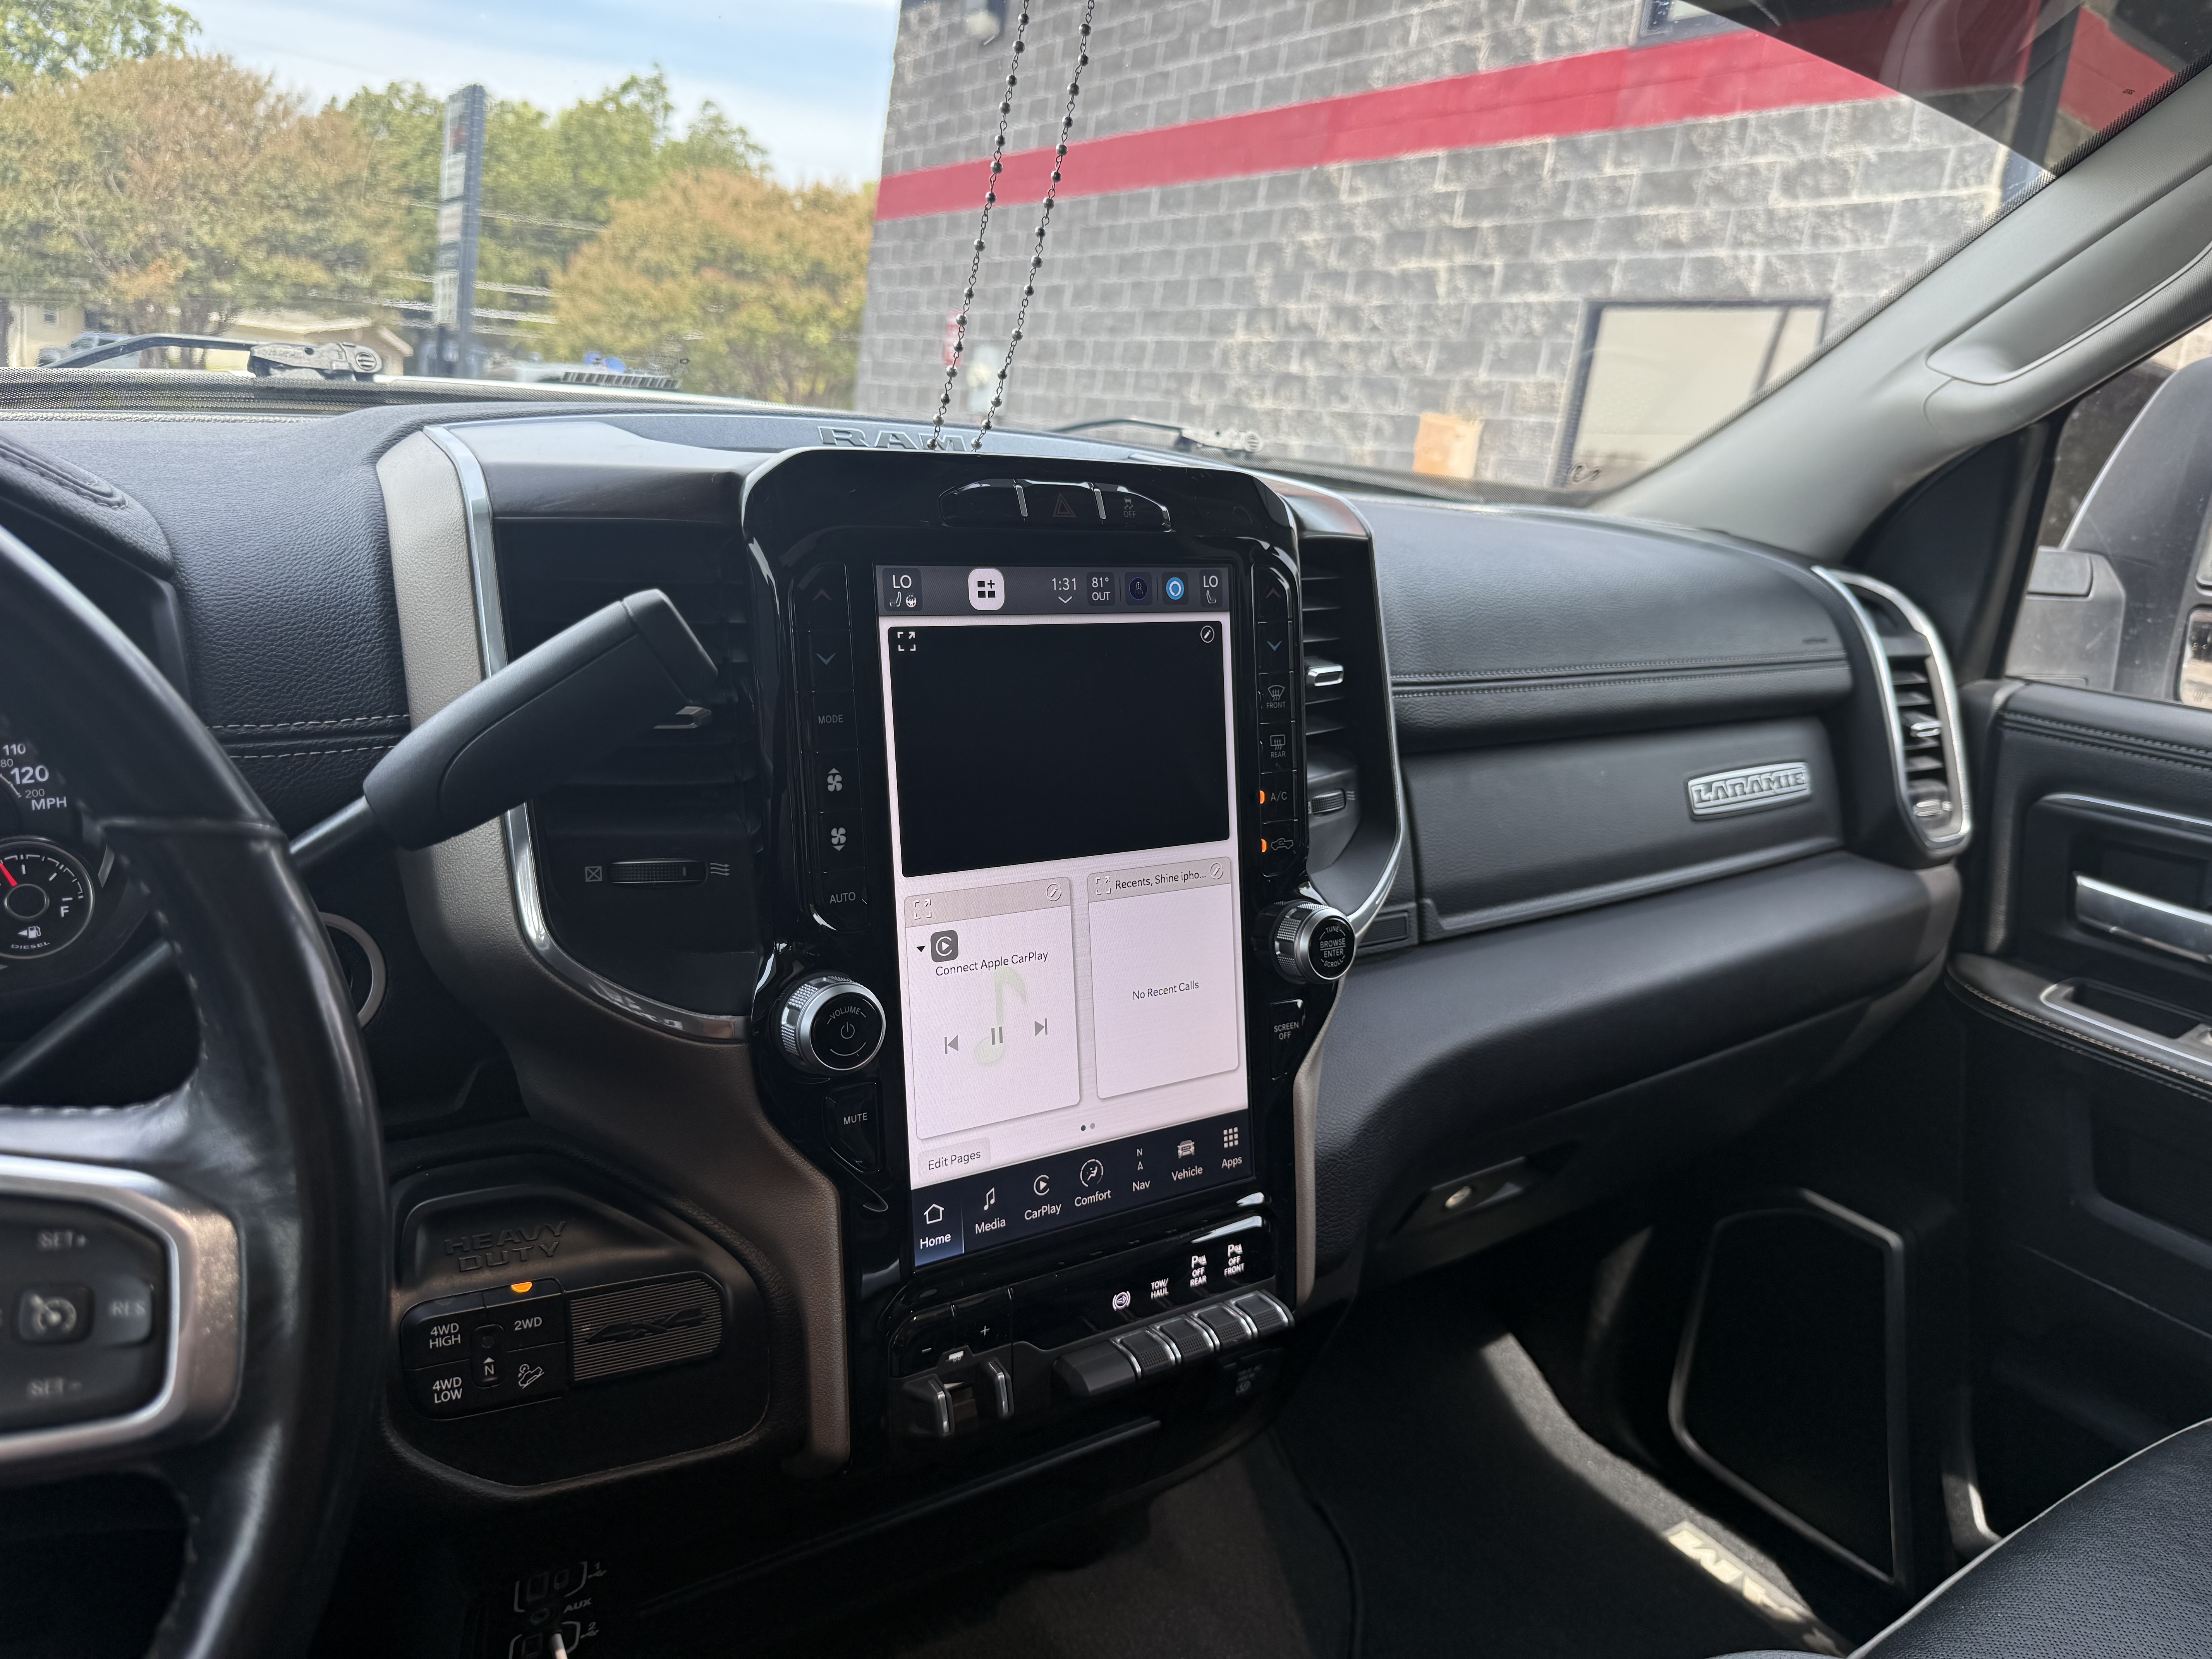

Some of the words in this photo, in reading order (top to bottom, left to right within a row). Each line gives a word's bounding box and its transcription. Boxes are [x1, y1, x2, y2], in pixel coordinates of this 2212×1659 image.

[818, 427, 967, 452] RAM
[893, 575, 912, 589] LO
[1052, 577, 1077, 591] 1:31
[1092, 577, 1109, 588] 81°
[1203, 575, 1218, 588] LO
[1092, 592, 1111, 601] OUT
[818, 714, 843, 724] MODE
[3, 744, 26, 756] 110
[10, 764, 49, 785] 120
[25, 788, 45, 798] 200
[1691, 769, 1806, 804] LARAMIE
[1270, 791, 1288, 802] A/C
[31, 796, 67, 811] MPH
[1115, 878, 1153, 890] Recents,
[1155, 874, 1179, 884] Shine
[830, 891, 856, 903] AUTO
[61, 905, 69, 917] F
[1320, 938, 1346, 948] BROWSE
[1324, 948, 1344, 958] ENTER
[935, 962, 978, 976] Connect
[981, 956, 1009, 970] Apple
[1011, 951, 1048, 964] CarPlay
[1324, 958, 1343, 967] SCROLL
[1133, 990, 1145, 1000] No
[1147, 985, 1177, 997] Recent
[1179, 980, 1199, 991] Calls
[830, 1006, 861, 1020] VOLUME
[1274, 1021, 1299, 1033] SCREEN
[1279, 1032, 1291, 1040] OFF
[844, 1112, 868, 1125] MUTE
[928, 1156, 948, 1170] Edit
[951, 1151, 981, 1165] Pages
[1221, 1156, 1242, 1169] Apps
[1171, 1165, 1203, 1181] Vehicle
[1132, 1180, 1151, 1192] Nav
[1075, 1189, 1111, 1207] Comfort
[1025, 1204, 1062, 1220] CarPlay
[975, 1218, 1006, 1234] Media
[444, 1221, 567, 1255] HEAVY
[920, 1233, 951, 1249] Home
[458, 1241, 560, 1272] DUTY
[1228, 1255, 1241, 1267] OFF
[1192, 1267, 1205, 1278] OFF
[1224, 1263, 1245, 1277] FRONT
[1151, 1278, 1169, 1290] TOW/
[1190, 1275, 1207, 1288] REAR
[1151, 1287, 1169, 1299] HAUL
[430, 1323, 459, 1336] 4WD
[514, 1317, 542, 1331] 2WD
[429, 1334, 461, 1349] HIGH
[485, 1364, 495, 1376] N
[433, 1377, 462, 1391] 4WD
[434, 1388, 462, 1403] LOW
[563, 1597, 592, 1613] AUX
